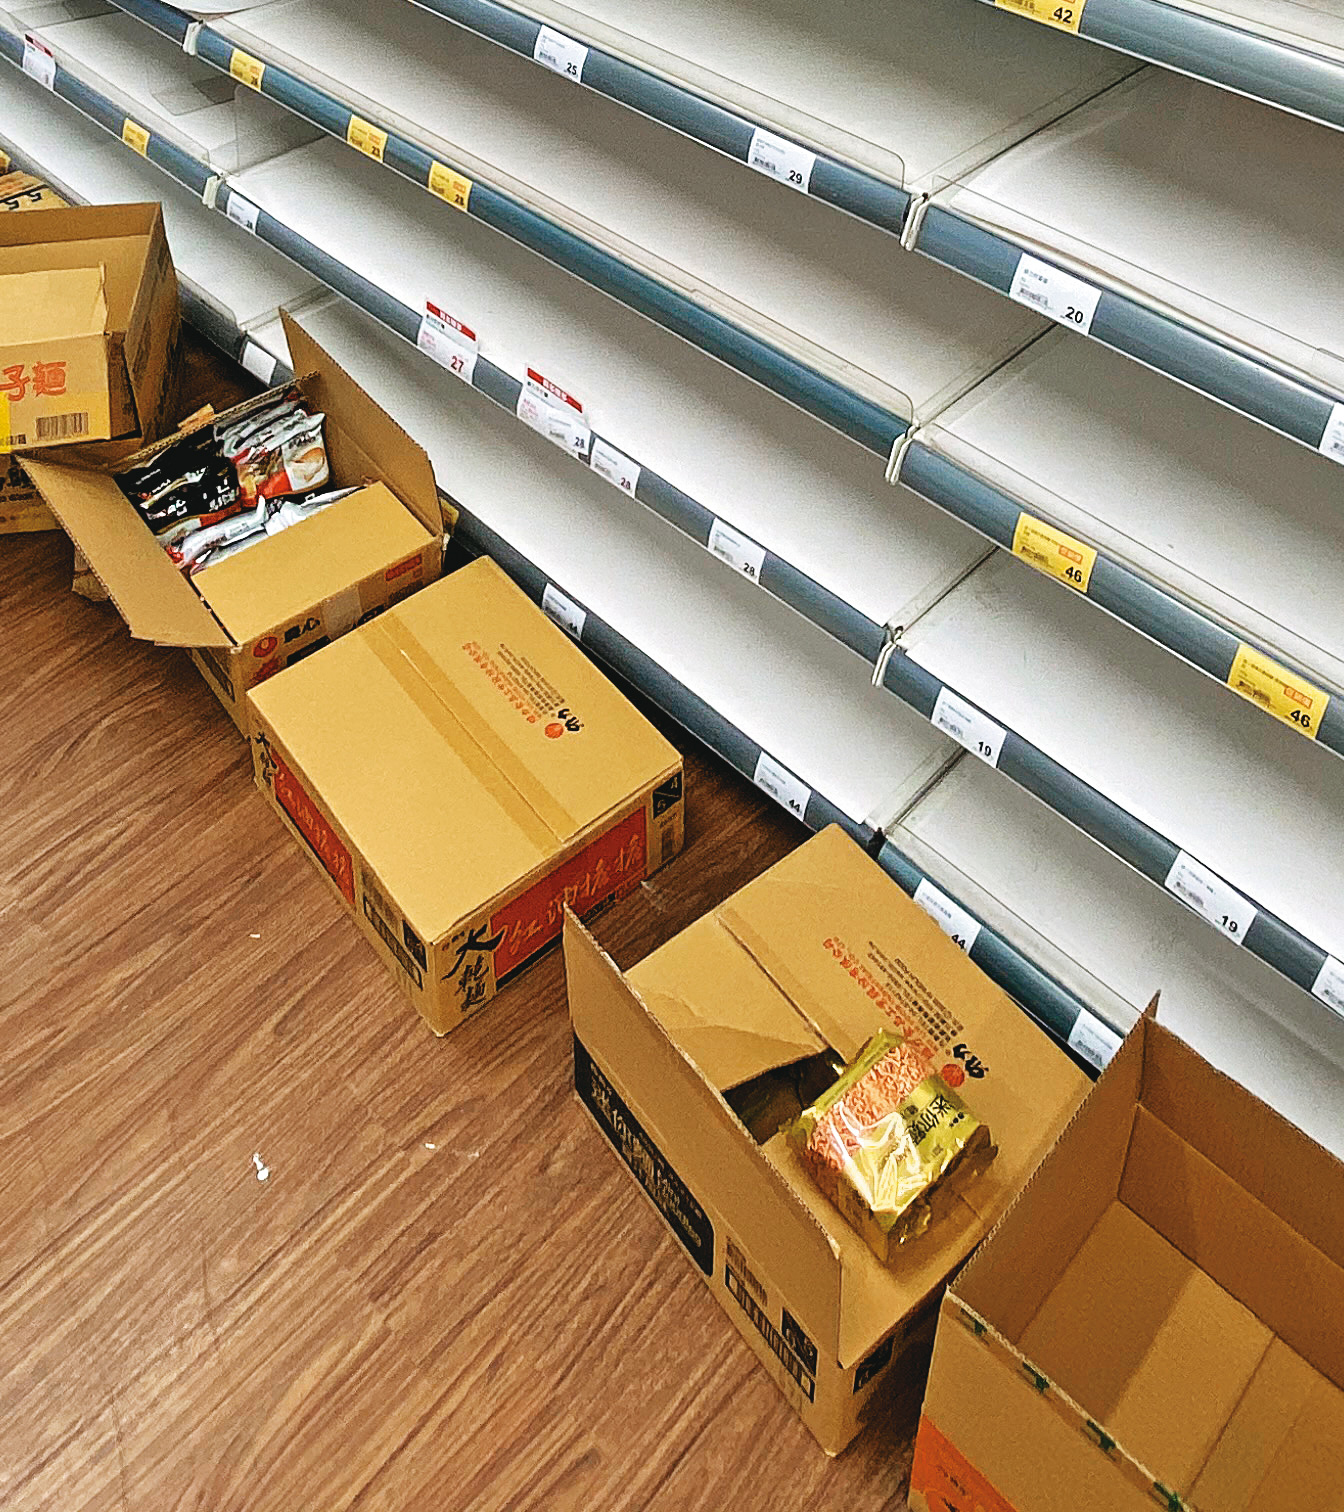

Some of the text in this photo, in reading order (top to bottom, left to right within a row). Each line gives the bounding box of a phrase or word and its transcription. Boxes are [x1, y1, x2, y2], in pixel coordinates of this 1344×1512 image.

[1053, 6, 1073, 24] 42
[567, 62, 578, 76] 25
[789, 170, 803, 185] 29
[1065, 306, 1084, 325] 20
[451, 355, 464, 372] 27
[574, 435, 586, 449] 28
[620, 476, 631, 492] 28
[744, 562, 756, 577] 28
[1065, 566, 1084, 585] 46
[1290, 708, 1311, 729] 46
[978, 740, 992, 757] 19
[1221, 915, 1238, 933] 19
[951, 932, 967, 950] 44
